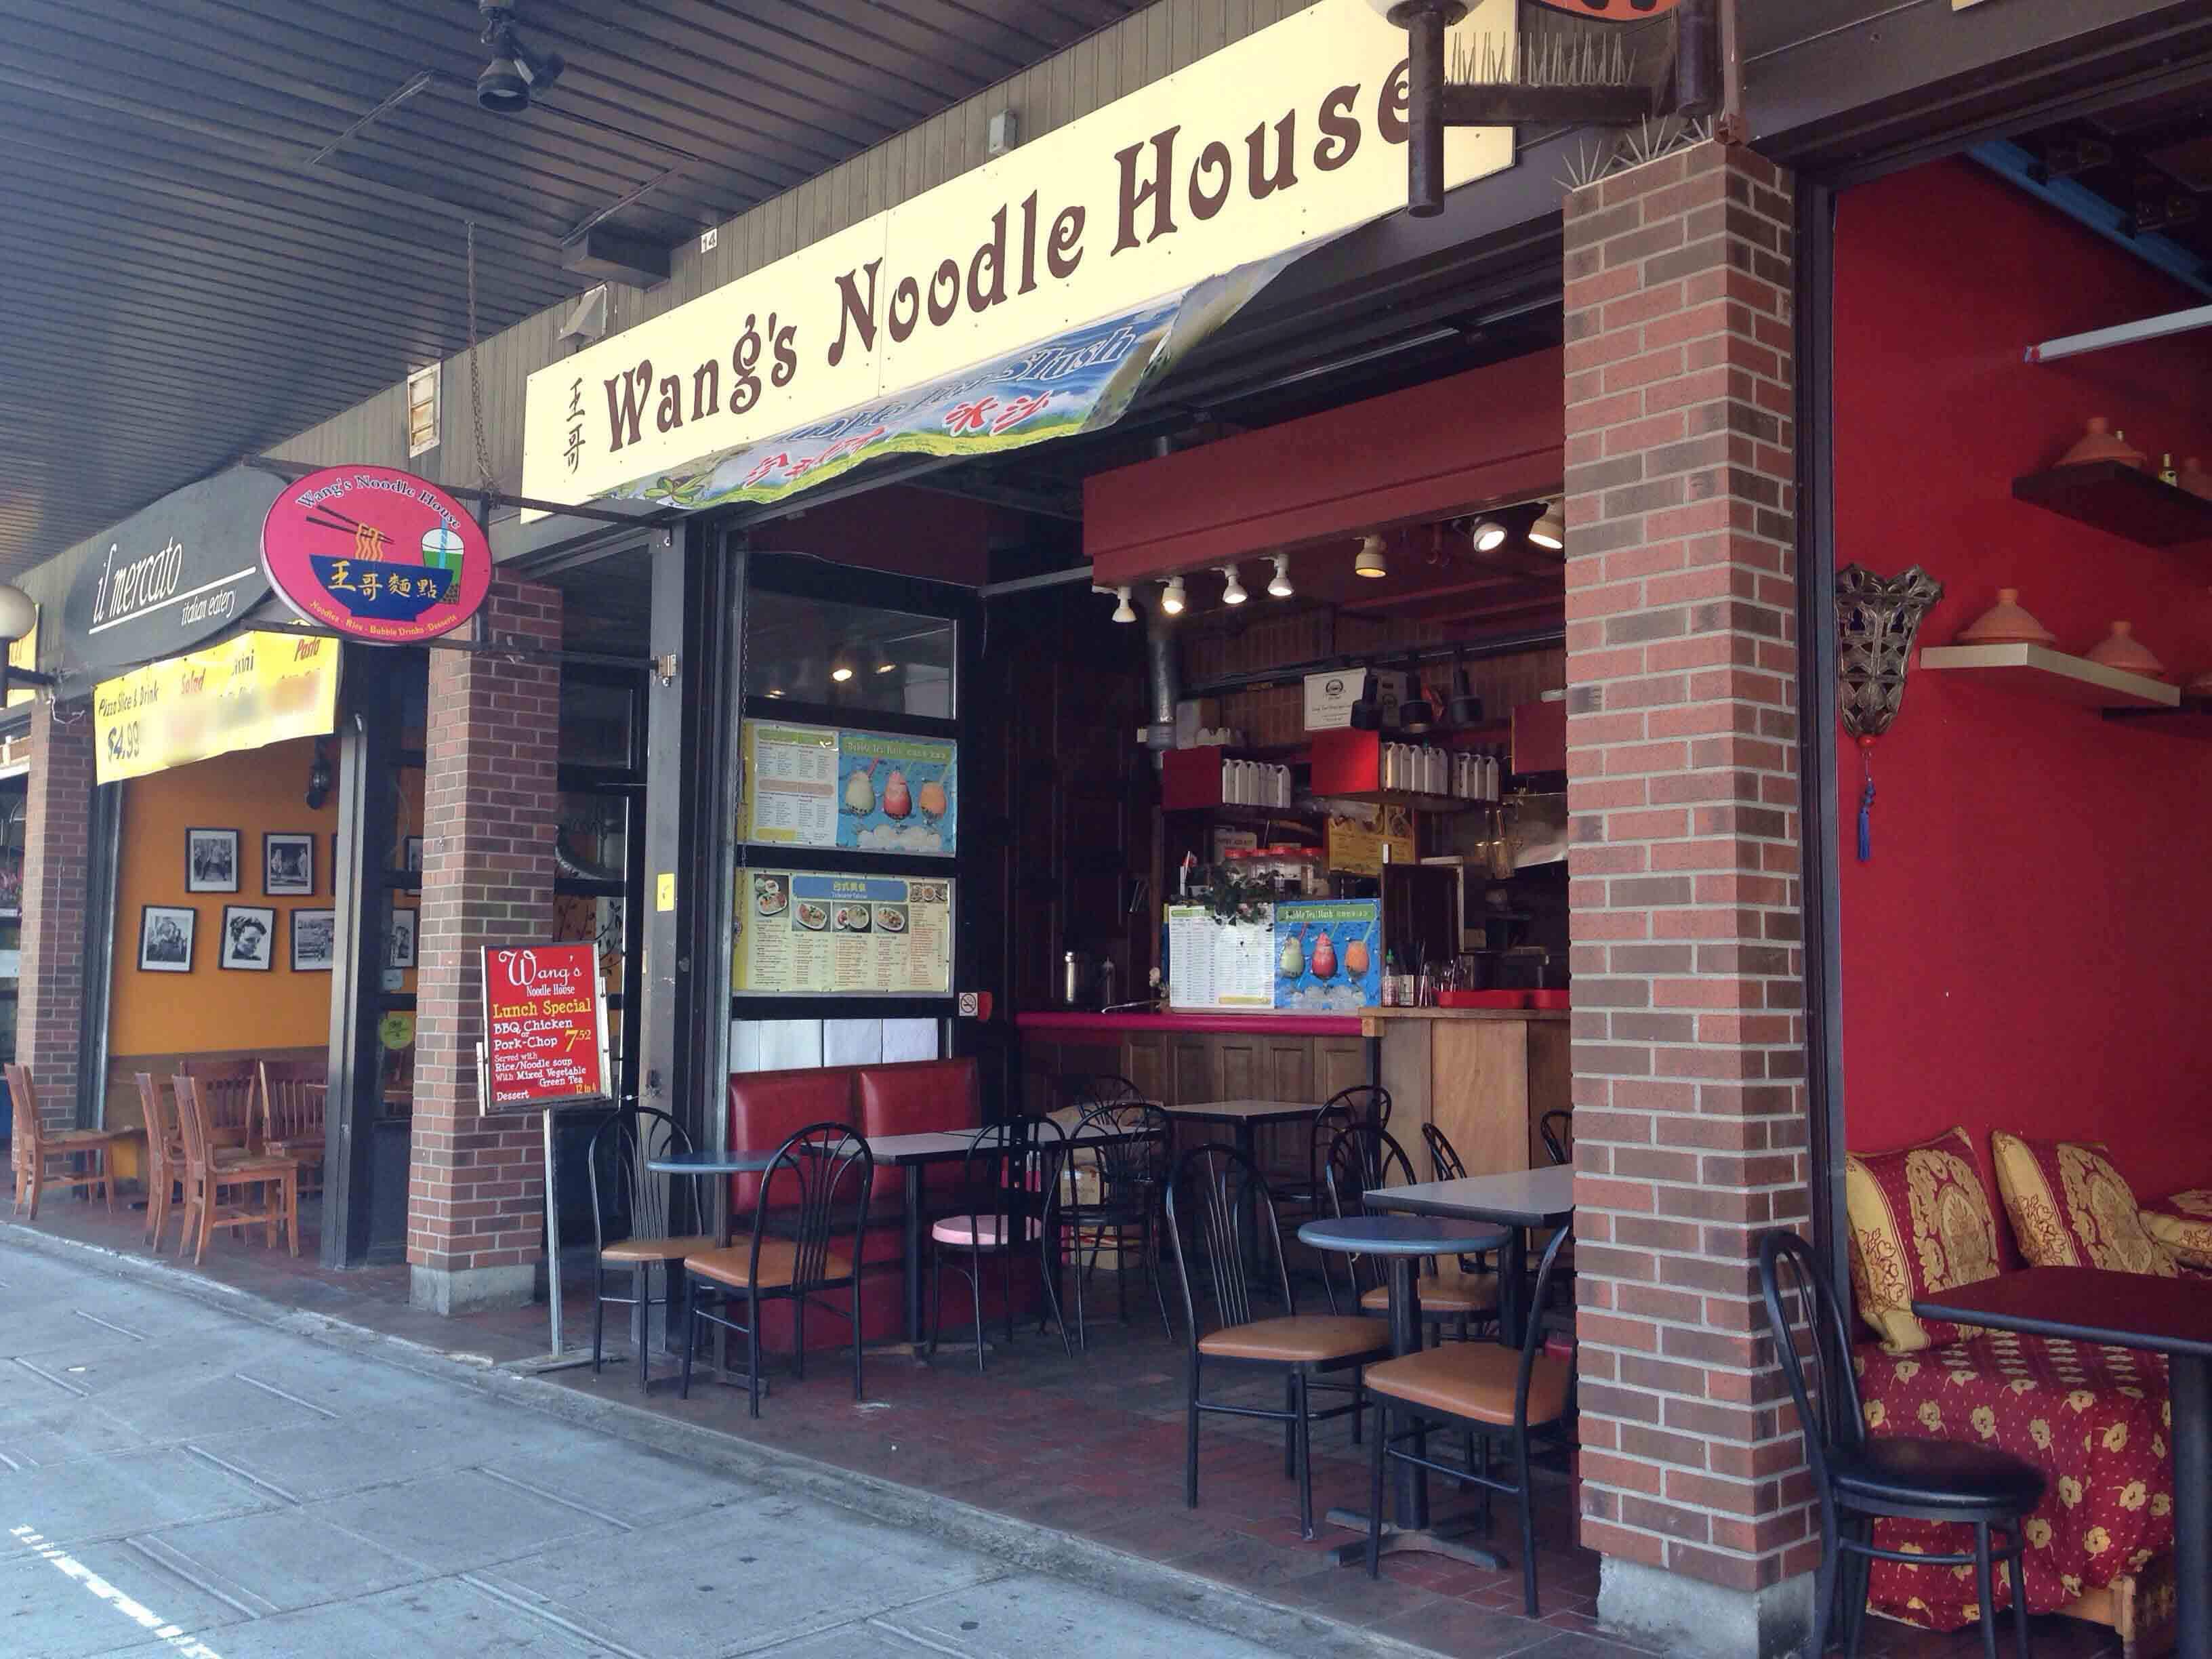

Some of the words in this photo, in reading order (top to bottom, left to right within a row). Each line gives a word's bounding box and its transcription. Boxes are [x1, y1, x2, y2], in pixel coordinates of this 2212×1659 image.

[604, 312, 797, 452] Wang's
[827, 189, 1086, 367] Noodle
[563, 377, 585, 474] 王哥
[295, 478, 352, 508] Wang's
[354, 475, 415, 497] Noodle
[417, 490, 460, 529] House
[93, 543, 117, 624] il
[109, 536, 182, 618] mercato
[328, 560, 437, 601] 王哥麵點
[181, 596, 206, 626] italian
[207, 588, 236, 618] eatery
[370, 625, 396, 636] Bubble
[293, 636, 321, 661] Pasta
[181, 668, 206, 695] Salad
[498, 950, 583, 987] Wang's
[527, 985, 551, 997] Noodle
[553, 984, 575, 995] House
[493, 1000, 537, 1019] Lunch
[543, 998, 592, 1017] Special
[493, 1022, 521, 1036] BBQ
[524, 1019, 573, 1032] Chicken
[493, 1036, 558, 1051] Pork-Chop
[494, 1054, 518, 1063] Served
[495, 1059, 550, 1072] Rice/Noodle
[553, 1059, 573, 1067] soup
[516, 1069, 544, 1080] Mixed
[546, 1066, 586, 1079] Vegetable
[539, 1078, 565, 1088] Green
[568, 1076, 583, 1084] Tea
[497, 1089, 530, 1101] Dessert
